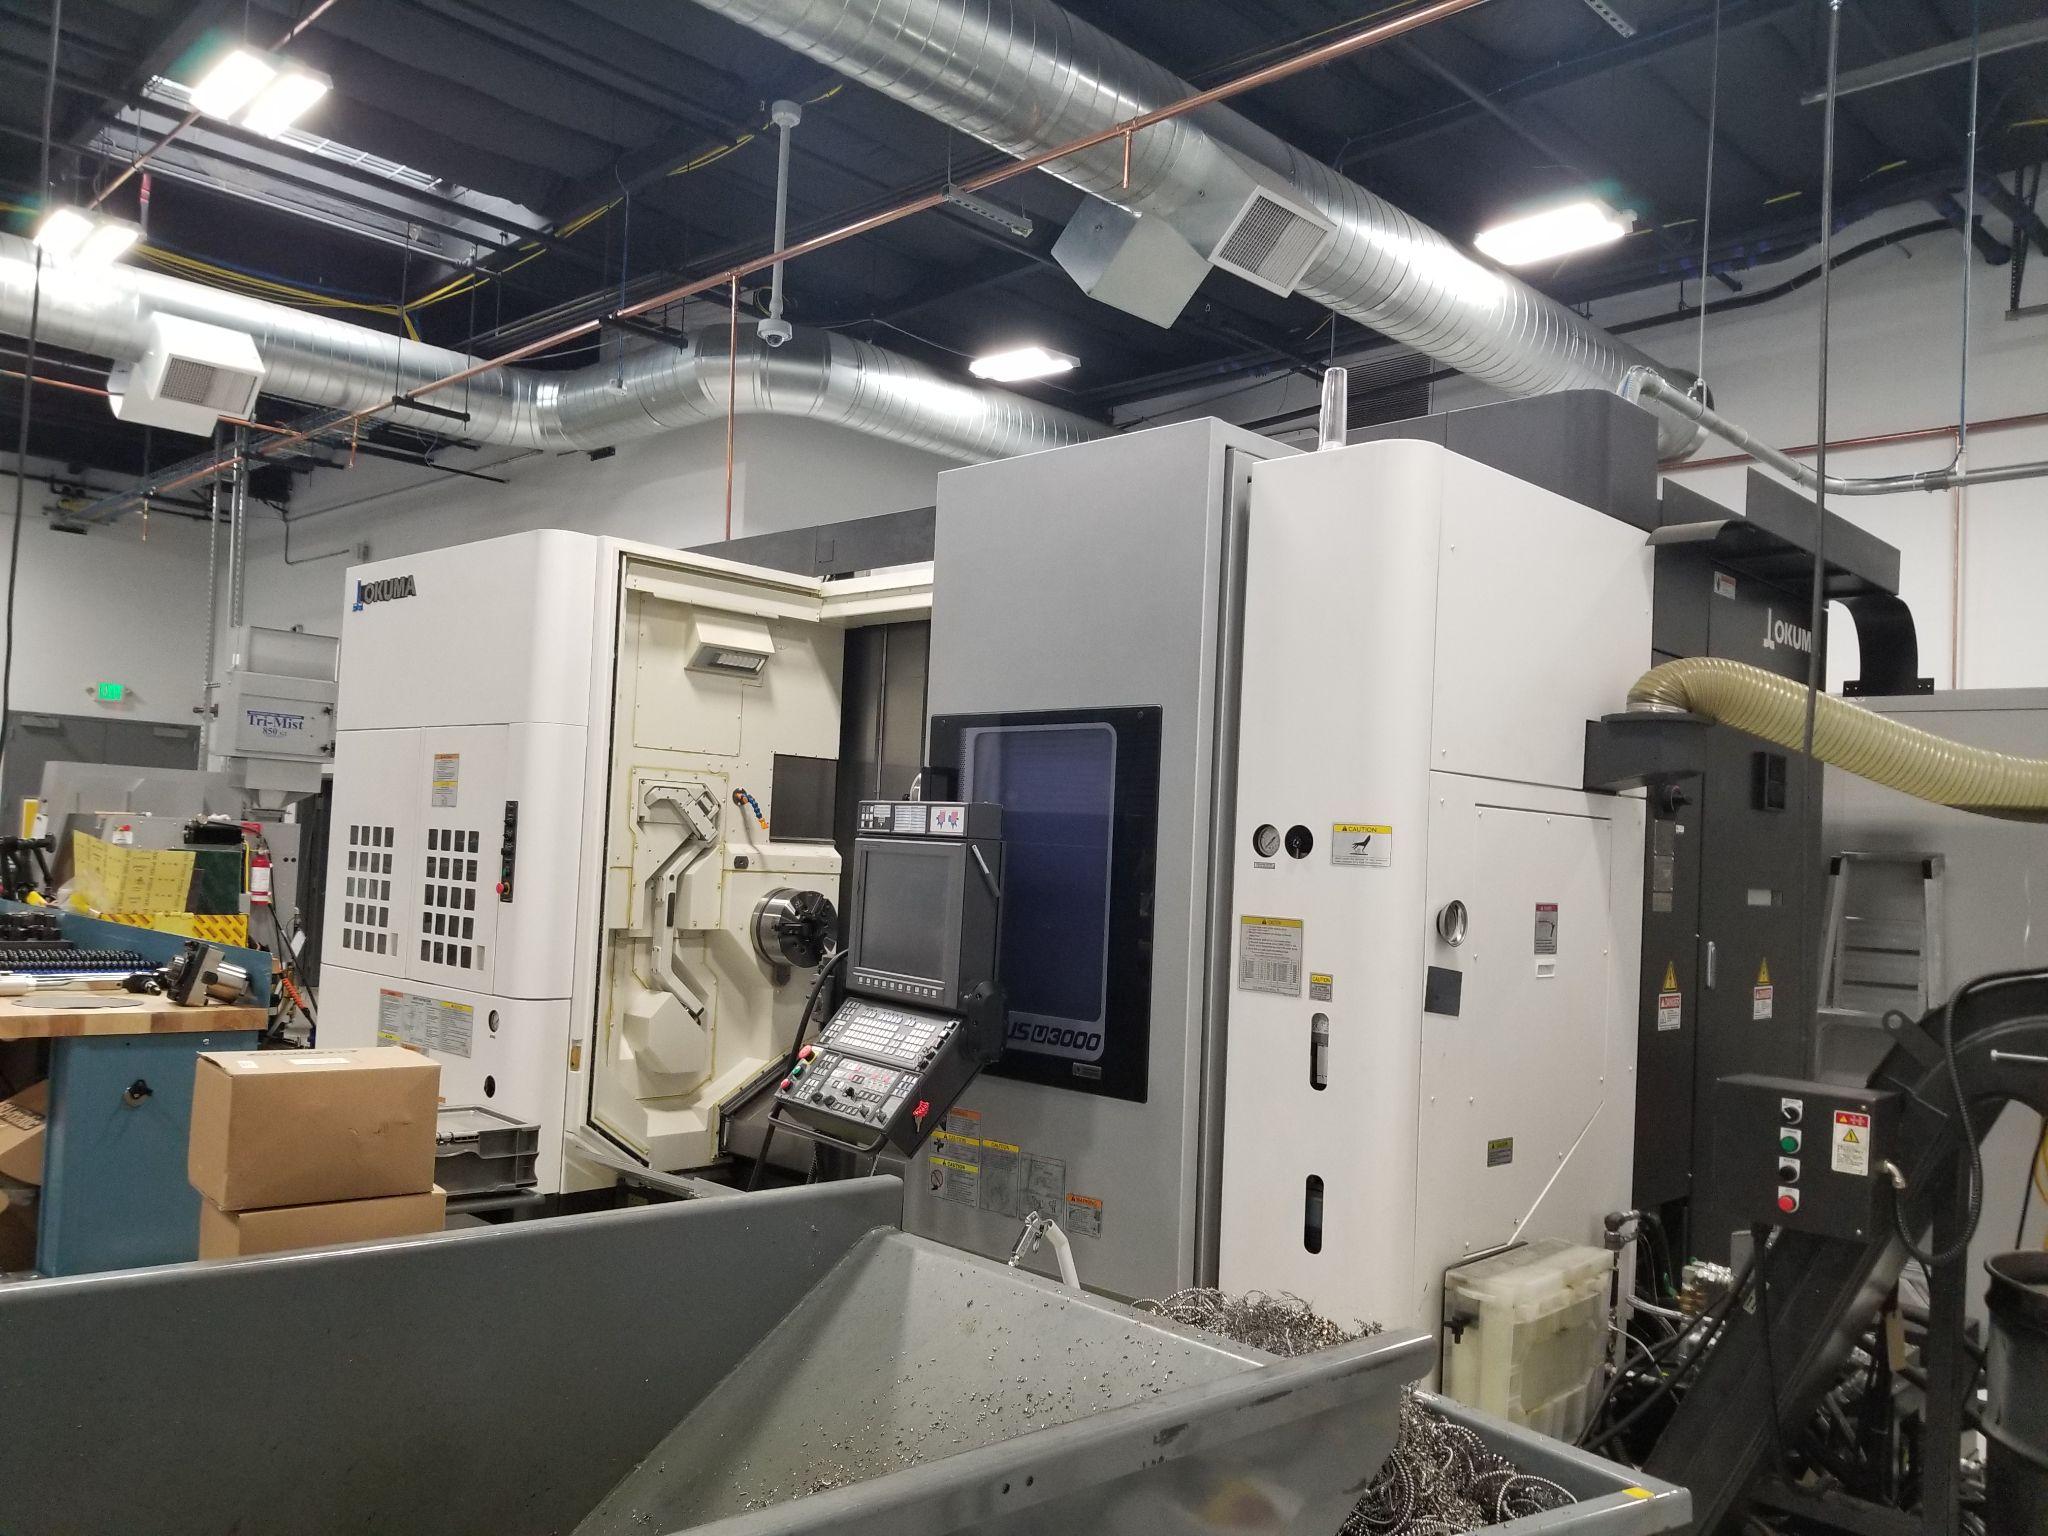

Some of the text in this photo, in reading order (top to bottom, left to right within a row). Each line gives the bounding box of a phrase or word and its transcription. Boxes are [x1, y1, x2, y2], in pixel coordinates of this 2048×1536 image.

[364, 575, 416, 604] OKUMA
[1774, 620, 1812, 653] OKUM
[248, 713, 303, 730] Tri-Mist
